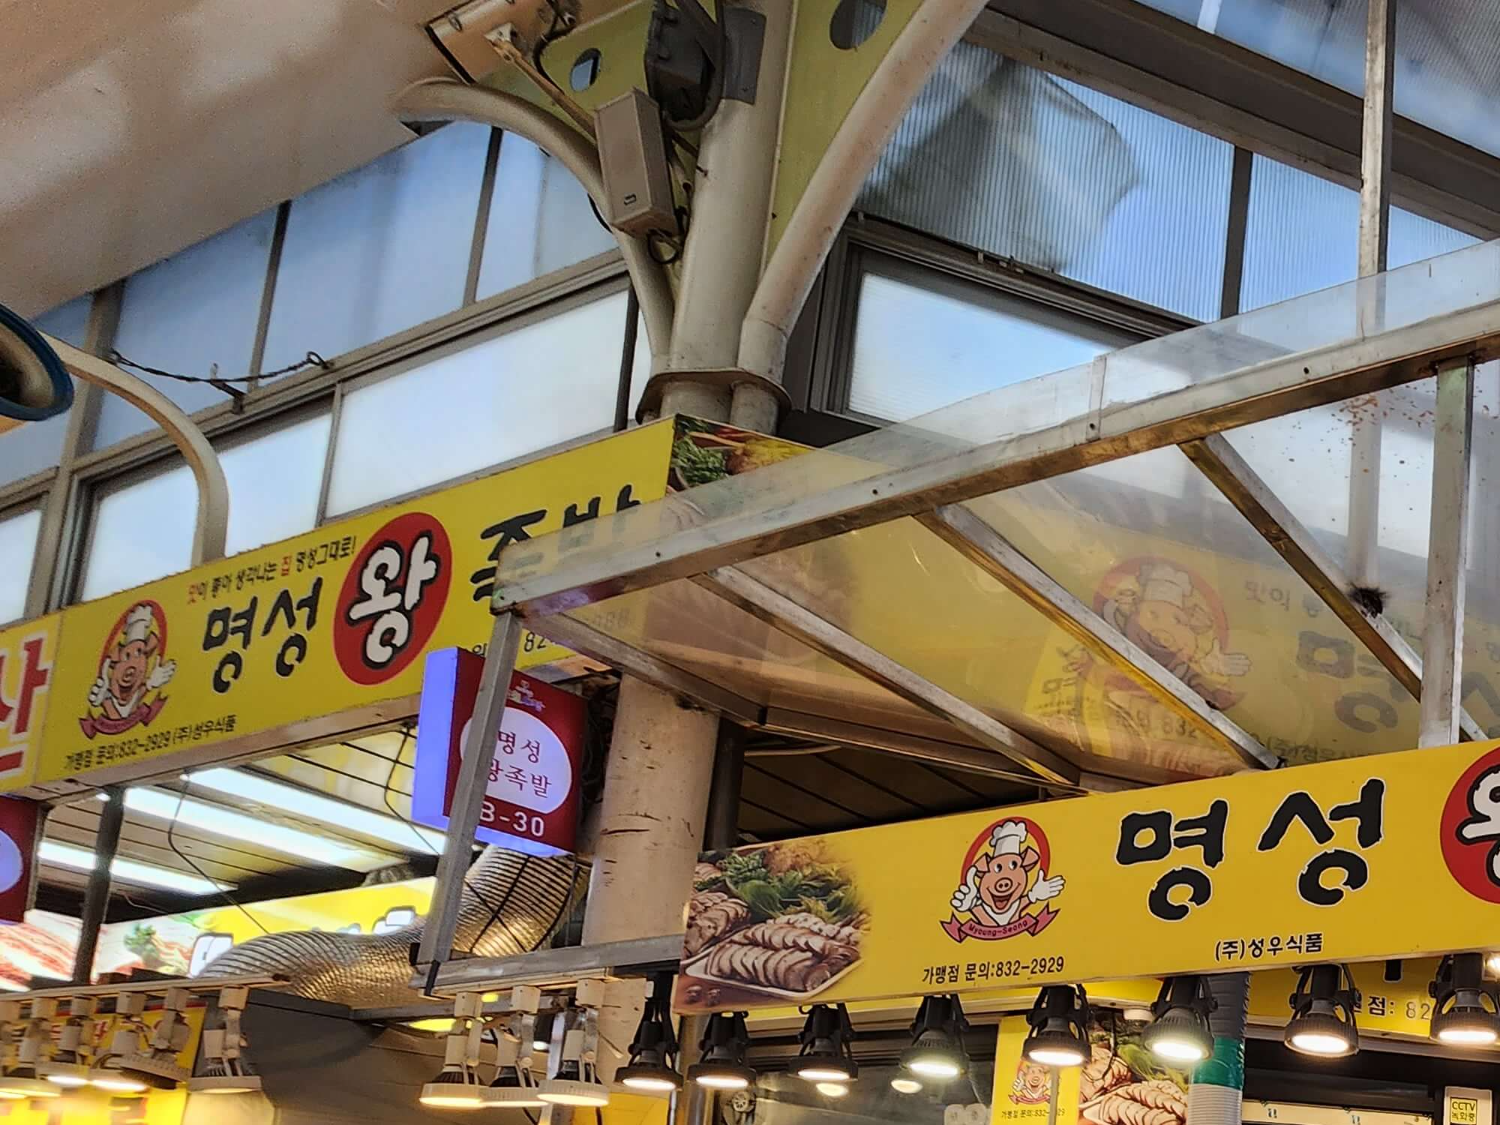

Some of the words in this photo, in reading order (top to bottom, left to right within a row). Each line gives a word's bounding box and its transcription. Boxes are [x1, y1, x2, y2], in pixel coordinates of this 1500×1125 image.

[202, 576, 323, 694] 명성
[346, 529, 441, 670] 왕
[480, 801, 545, 837] B-30
[1116, 778, 1386, 922] 명성
[968, 918, 1028, 937] Myoung-Seong
[1215, 933, 1323, 961] (주)성우식품
[922, 965, 960, 985] 가맹점
[965, 956, 1065, 981] 문의:832-2929
[1020, 1108, 1066, 1118] 문의:832-29
[1451, 1100, 1476, 1111] CCTV
